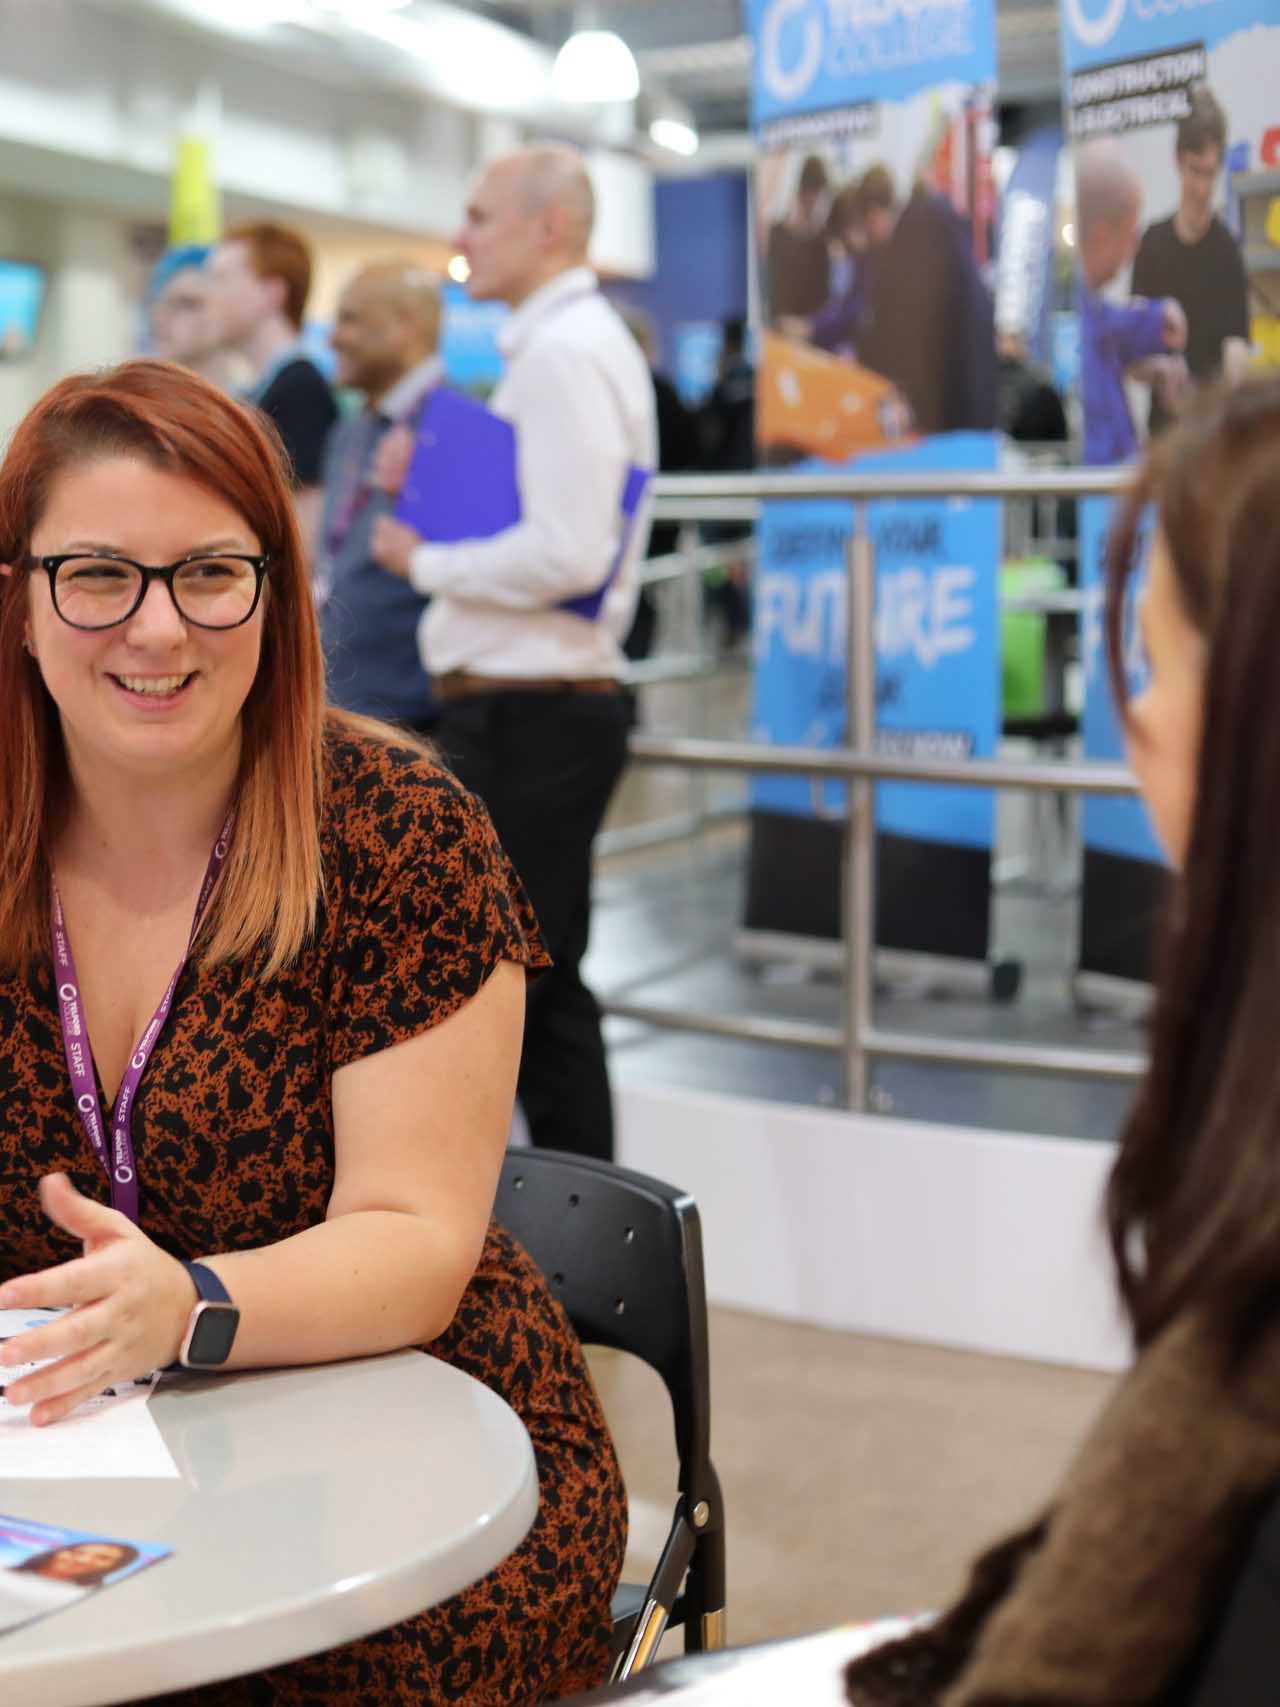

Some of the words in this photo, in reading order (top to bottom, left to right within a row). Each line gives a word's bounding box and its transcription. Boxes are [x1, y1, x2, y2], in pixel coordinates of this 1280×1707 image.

[55, 931, 68, 967] STAFF
[70, 1042, 85, 1078] STAFF
[118, 1086, 131, 1123] STAFF
[115, 1128, 123, 1166] TELFORD
